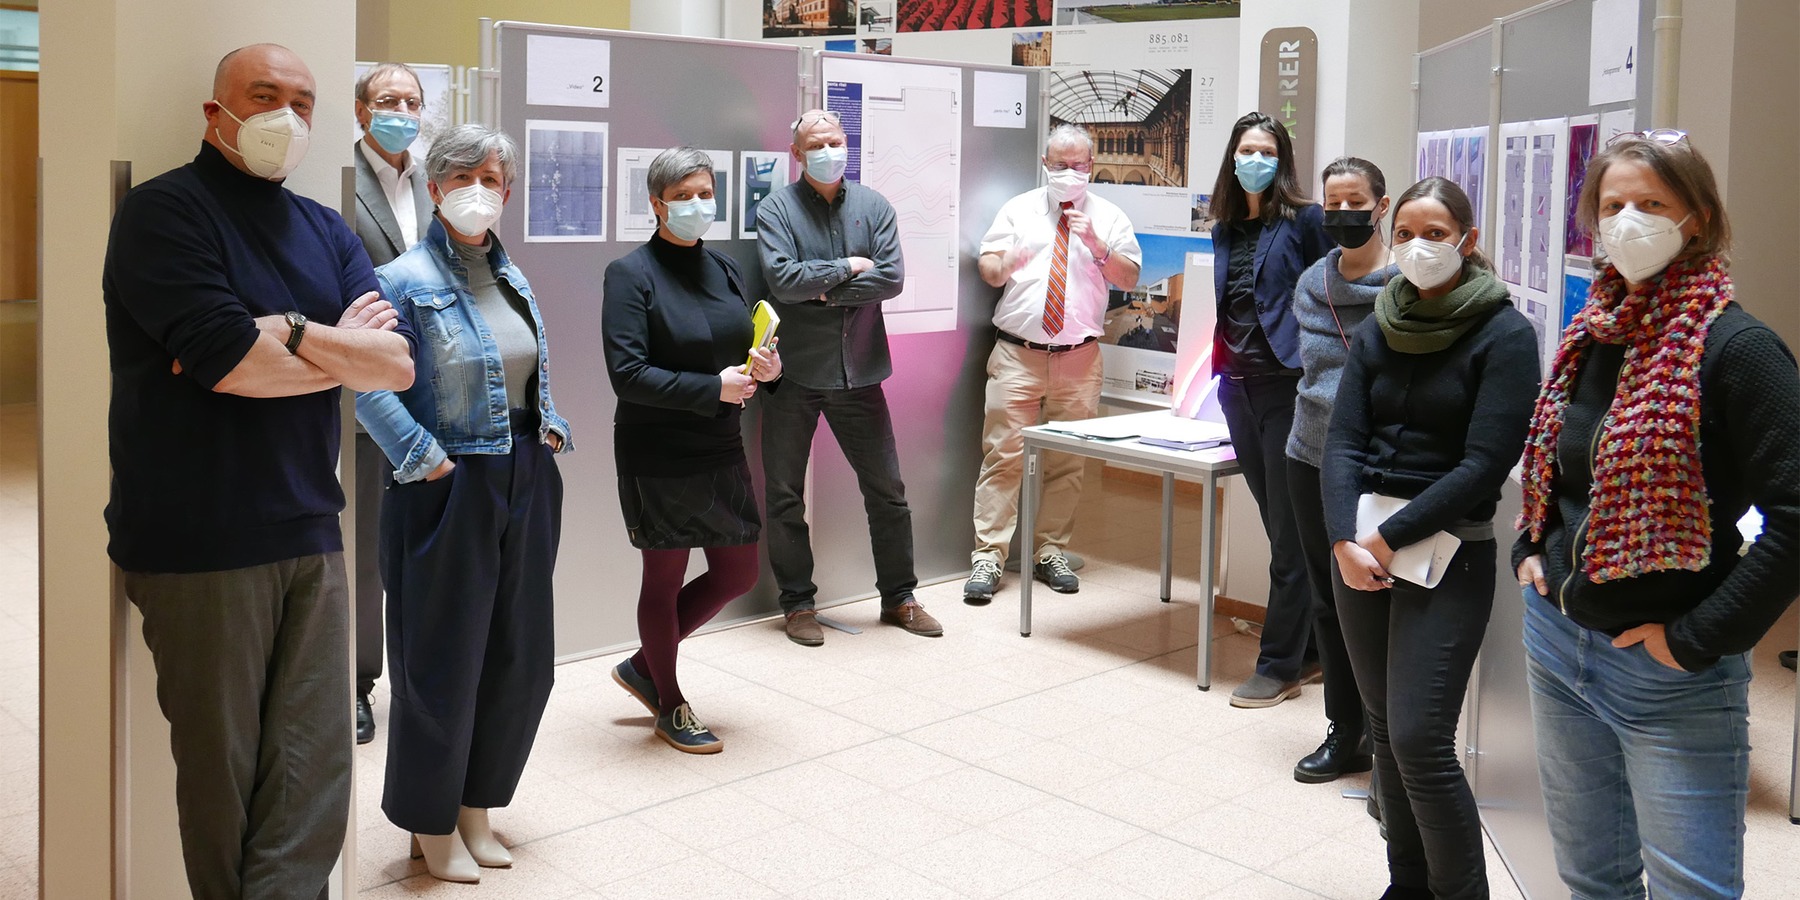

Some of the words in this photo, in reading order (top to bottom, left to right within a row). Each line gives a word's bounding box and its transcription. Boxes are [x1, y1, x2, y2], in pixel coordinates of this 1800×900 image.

[1626, 45, 1633, 75] 4
[593, 75, 603, 93] 2
[1015, 102, 1022, 116] 3
[1279, 39, 1301, 155] A+RER
